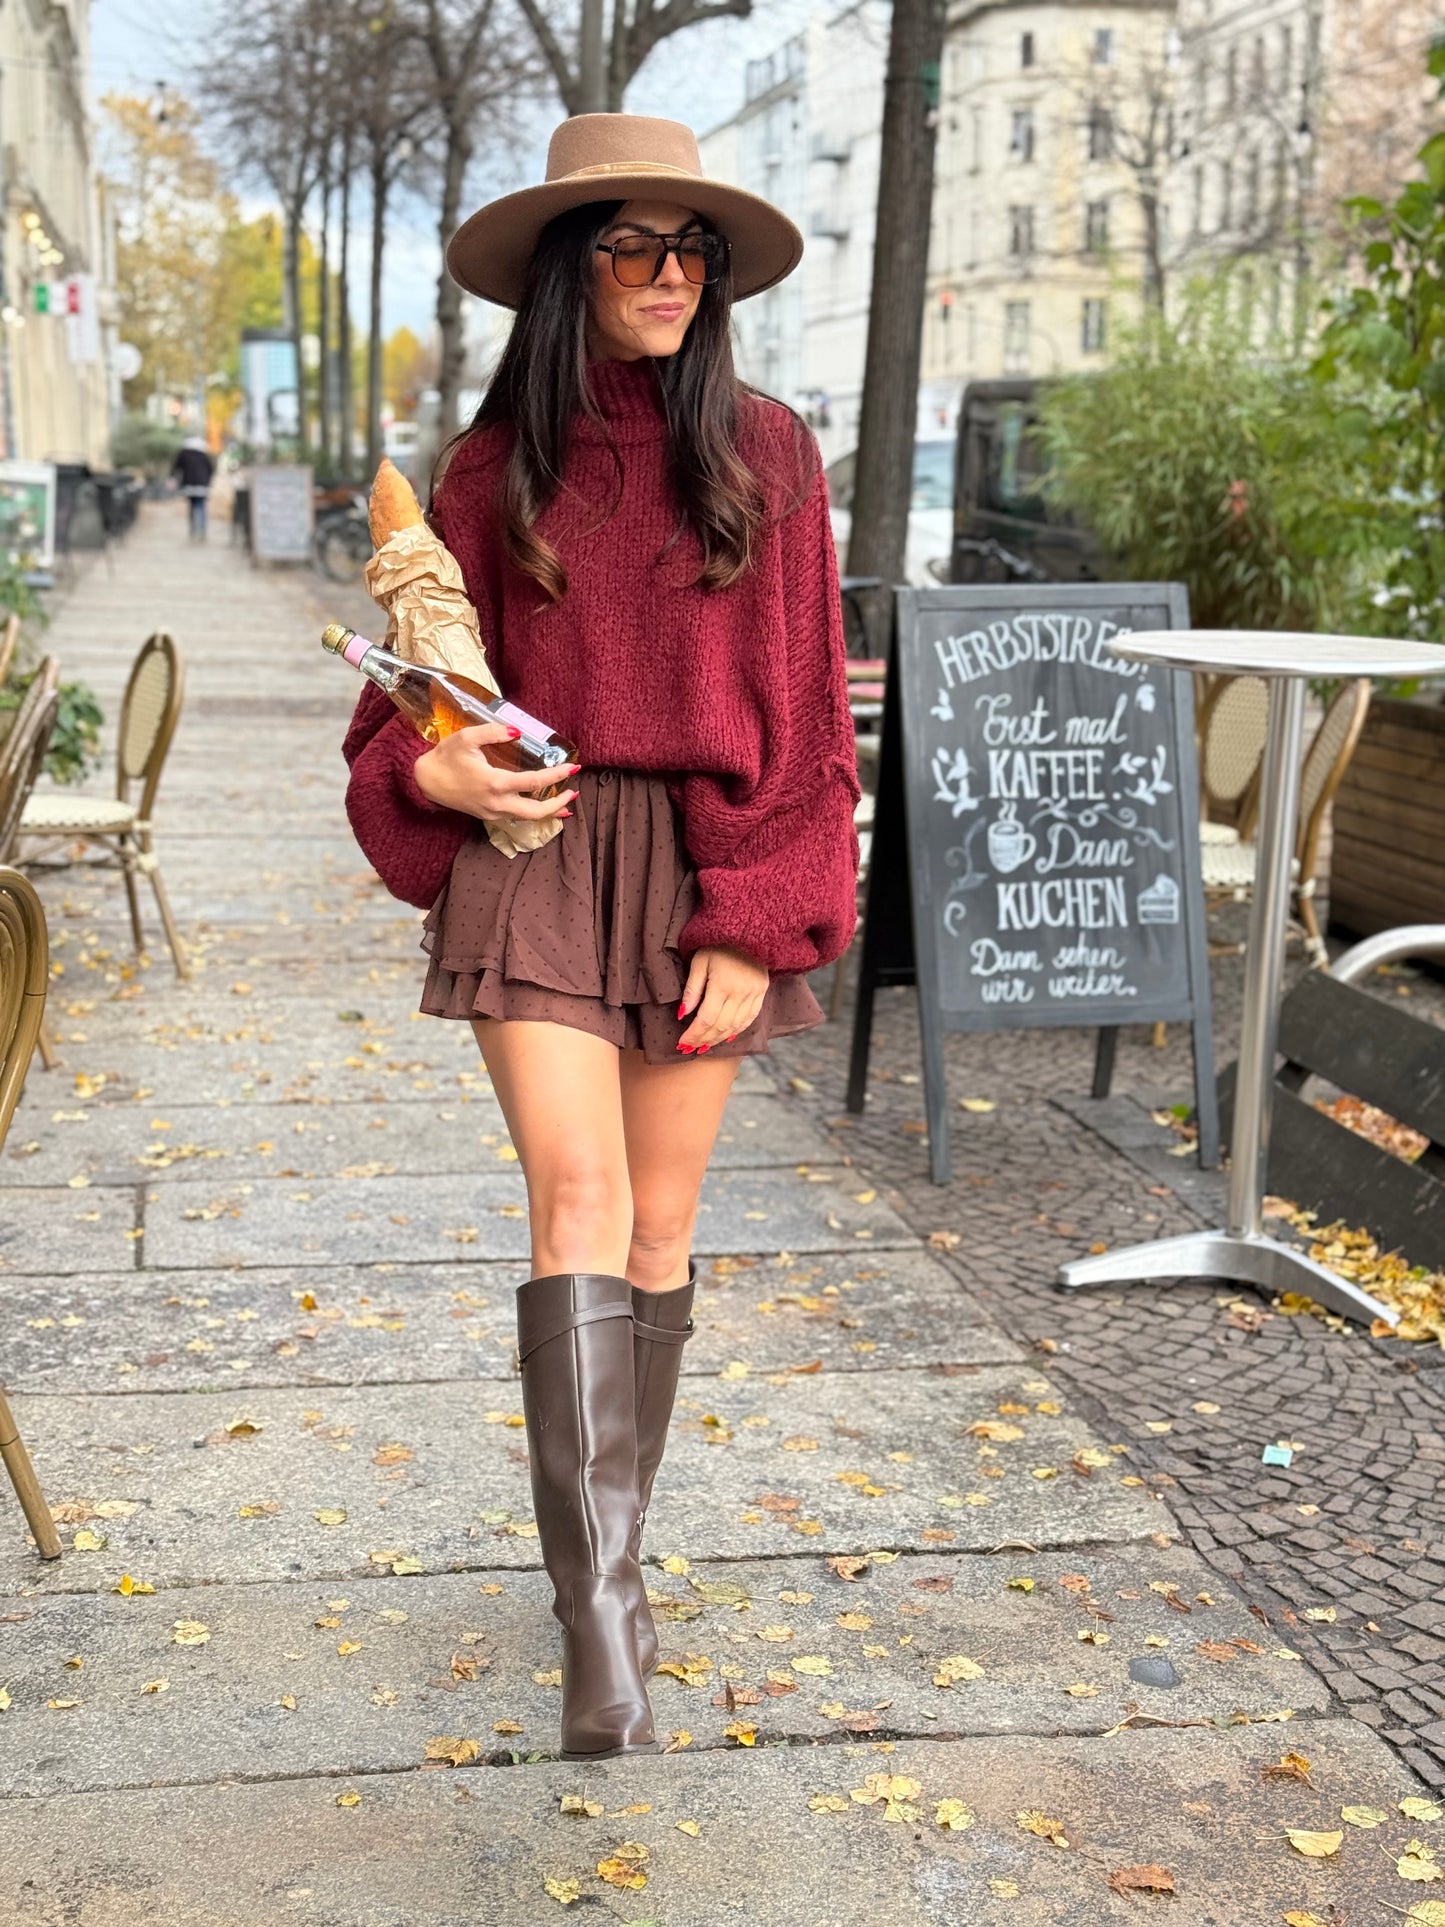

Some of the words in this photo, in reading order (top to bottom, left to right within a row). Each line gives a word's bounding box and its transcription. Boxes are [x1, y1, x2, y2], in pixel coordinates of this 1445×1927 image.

[975, 693, 1058, 745] Erst
[1065, 693, 1128, 744] mal
[988, 750, 1122, 800] KAFFEE.
[1035, 822, 1134, 874] Dann
[996, 876, 1129, 931] KUCHEN
[970, 937, 1044, 977] Dann
[1052, 931, 1127, 970] sehen
[981, 973, 1035, 1003] wir
[1048, 968, 1138, 998] weiter.
